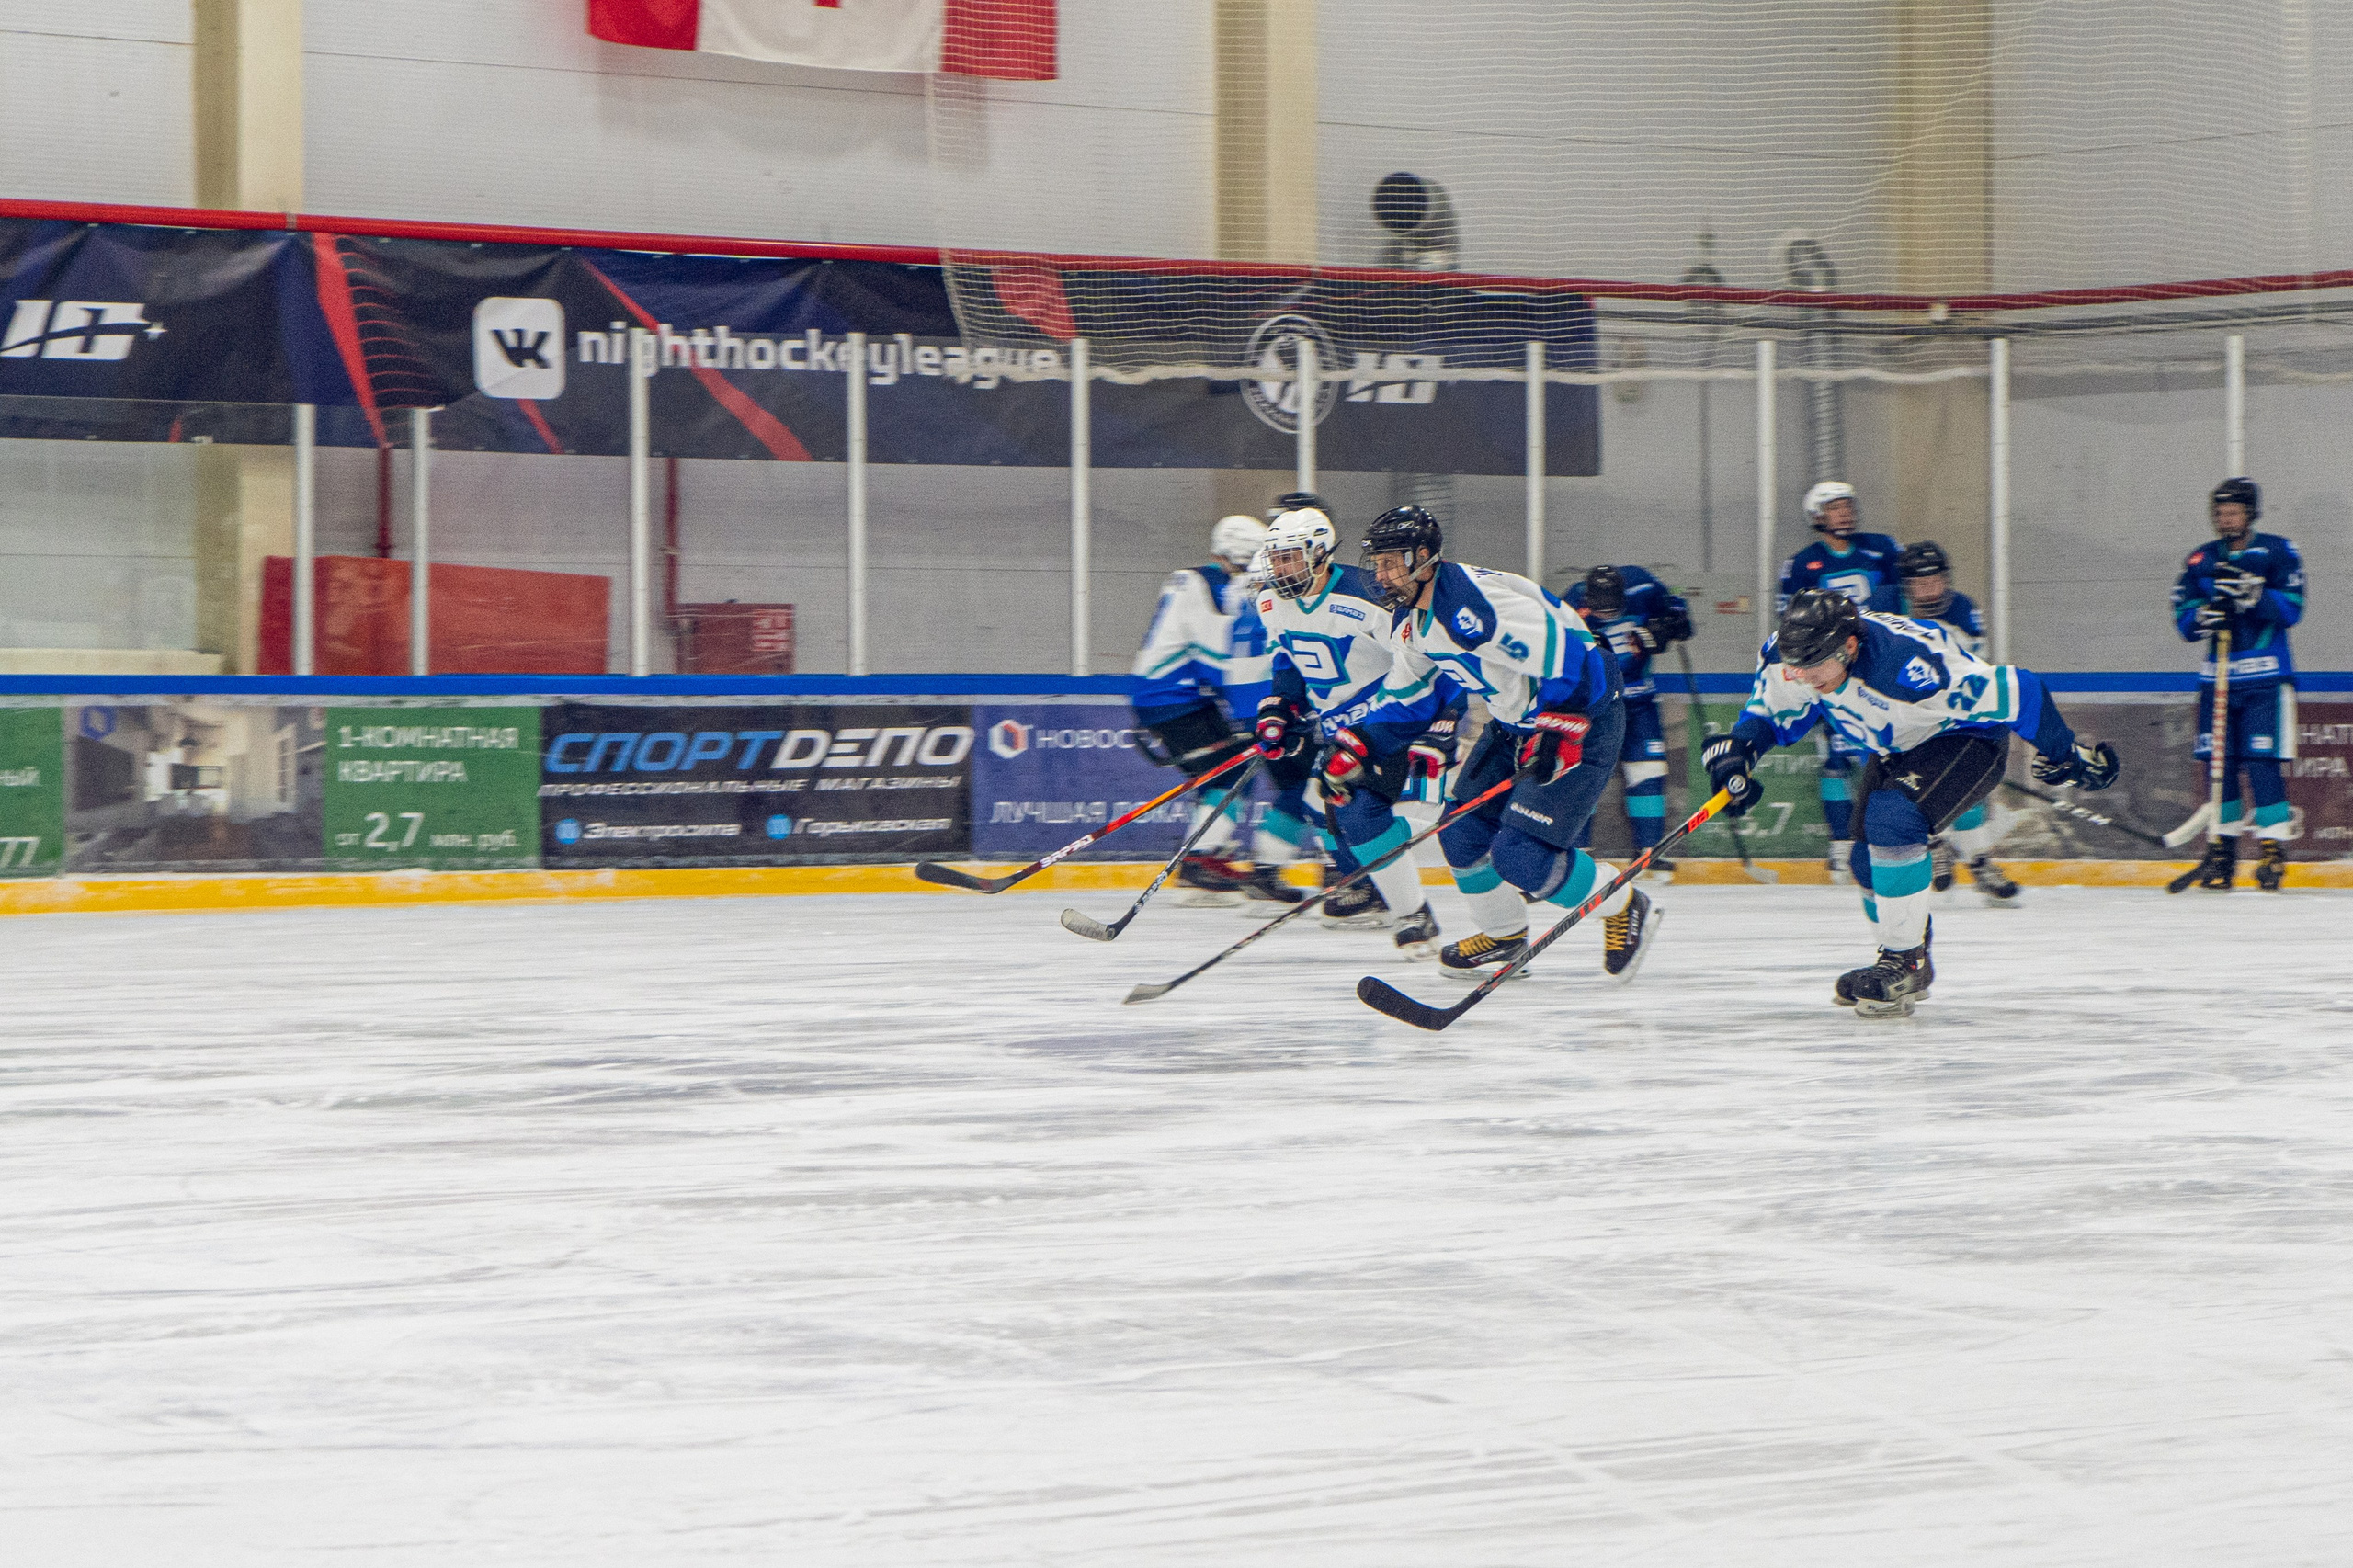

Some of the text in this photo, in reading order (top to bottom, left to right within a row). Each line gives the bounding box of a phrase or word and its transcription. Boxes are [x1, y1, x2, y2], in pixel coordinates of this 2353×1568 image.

[1496, 631, 1531, 664] 5
[337, 725, 520, 749] 1-КОМНАТНАЯ
[337, 760, 470, 782] КВАРТИРА
[813, 775, 962, 791] МАГАЗИНЫ
[990, 801, 1107, 824] ЛУЧШАЯ
[364, 812, 425, 852] 2,7
